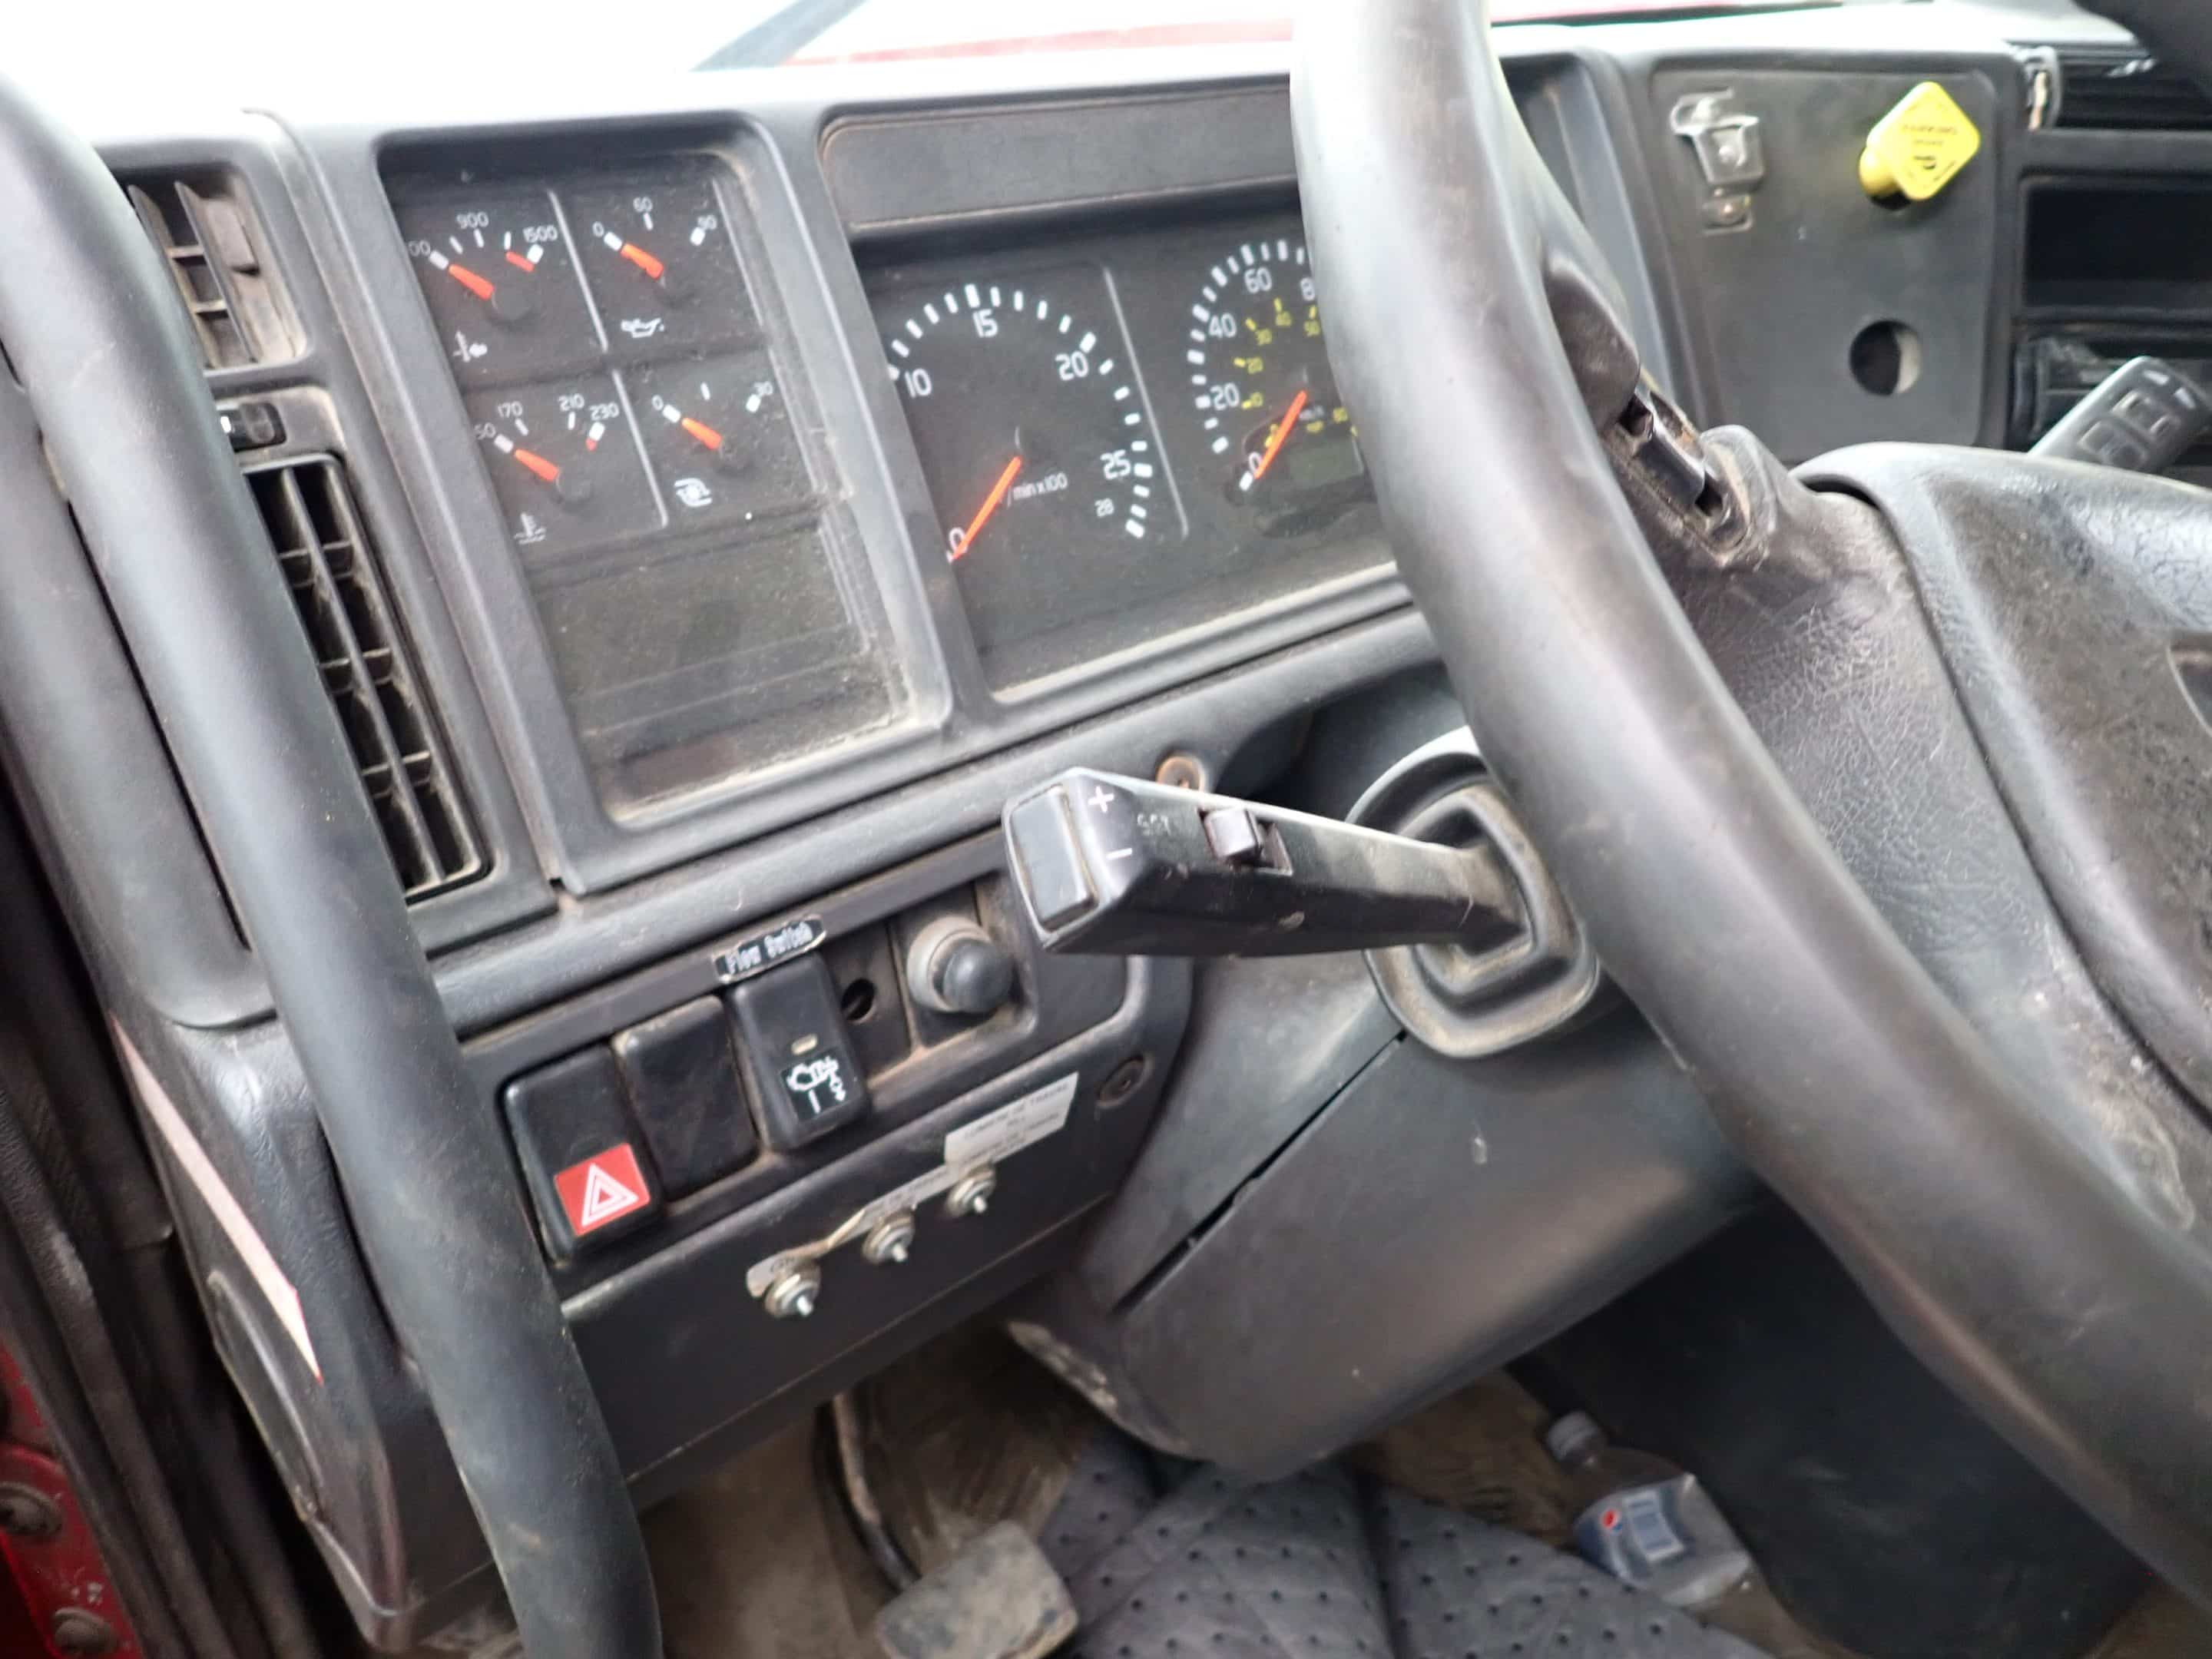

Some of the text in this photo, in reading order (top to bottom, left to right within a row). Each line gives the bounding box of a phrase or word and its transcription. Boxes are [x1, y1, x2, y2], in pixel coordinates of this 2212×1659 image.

[457, 211, 488, 229] 900
[592, 220, 604, 237] 0
[1243, 267, 1273, 294] 60
[972, 308, 998, 338] 15
[1208, 312, 1237, 339] 40
[1055, 350, 1089, 381] 20
[905, 368, 932, 399] 10
[1210, 382, 1240, 411] 20
[652, 394, 664, 411] 0
[1100, 449, 1131, 480] 25
[1094, 498, 1114, 518] 28
[949, 527, 968, 555] 0
